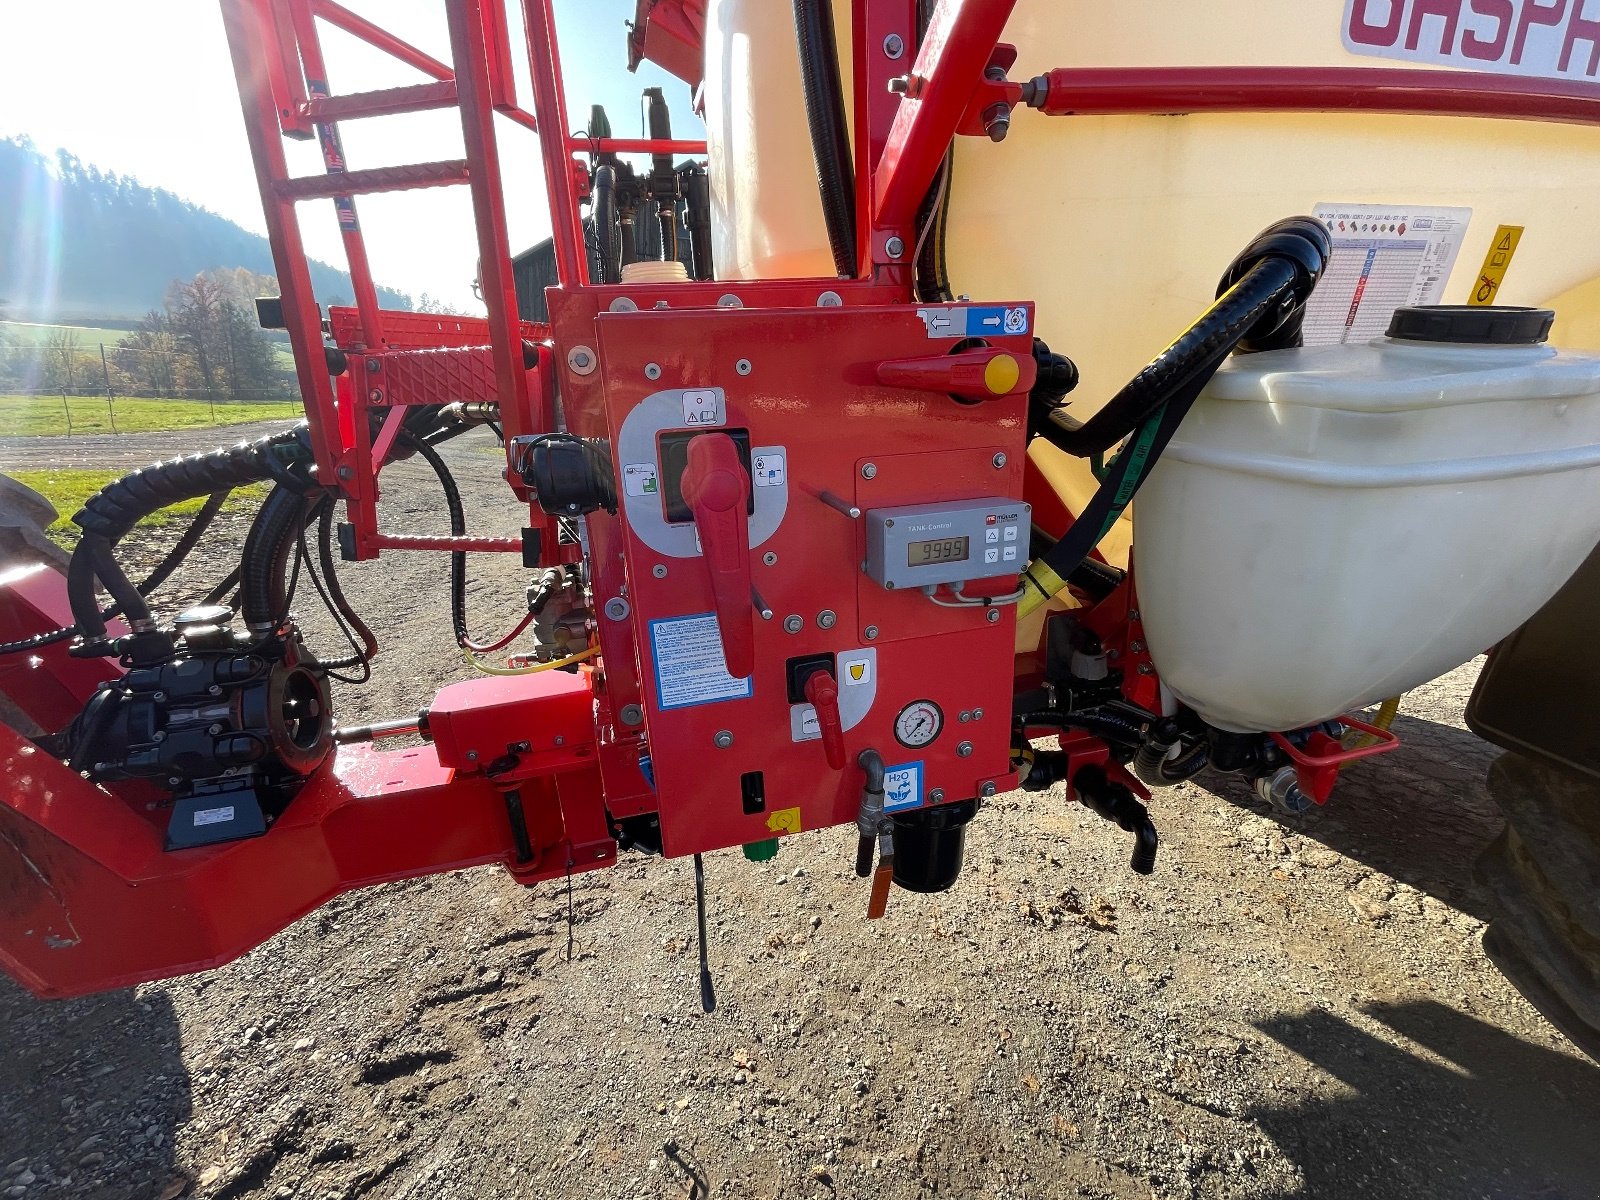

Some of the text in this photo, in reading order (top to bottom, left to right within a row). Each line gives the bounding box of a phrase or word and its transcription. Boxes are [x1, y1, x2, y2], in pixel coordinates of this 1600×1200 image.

[908, 522, 952, 532] TANK-Control
[923, 541, 962, 560] 9999
[889, 771, 909, 783] H2O
